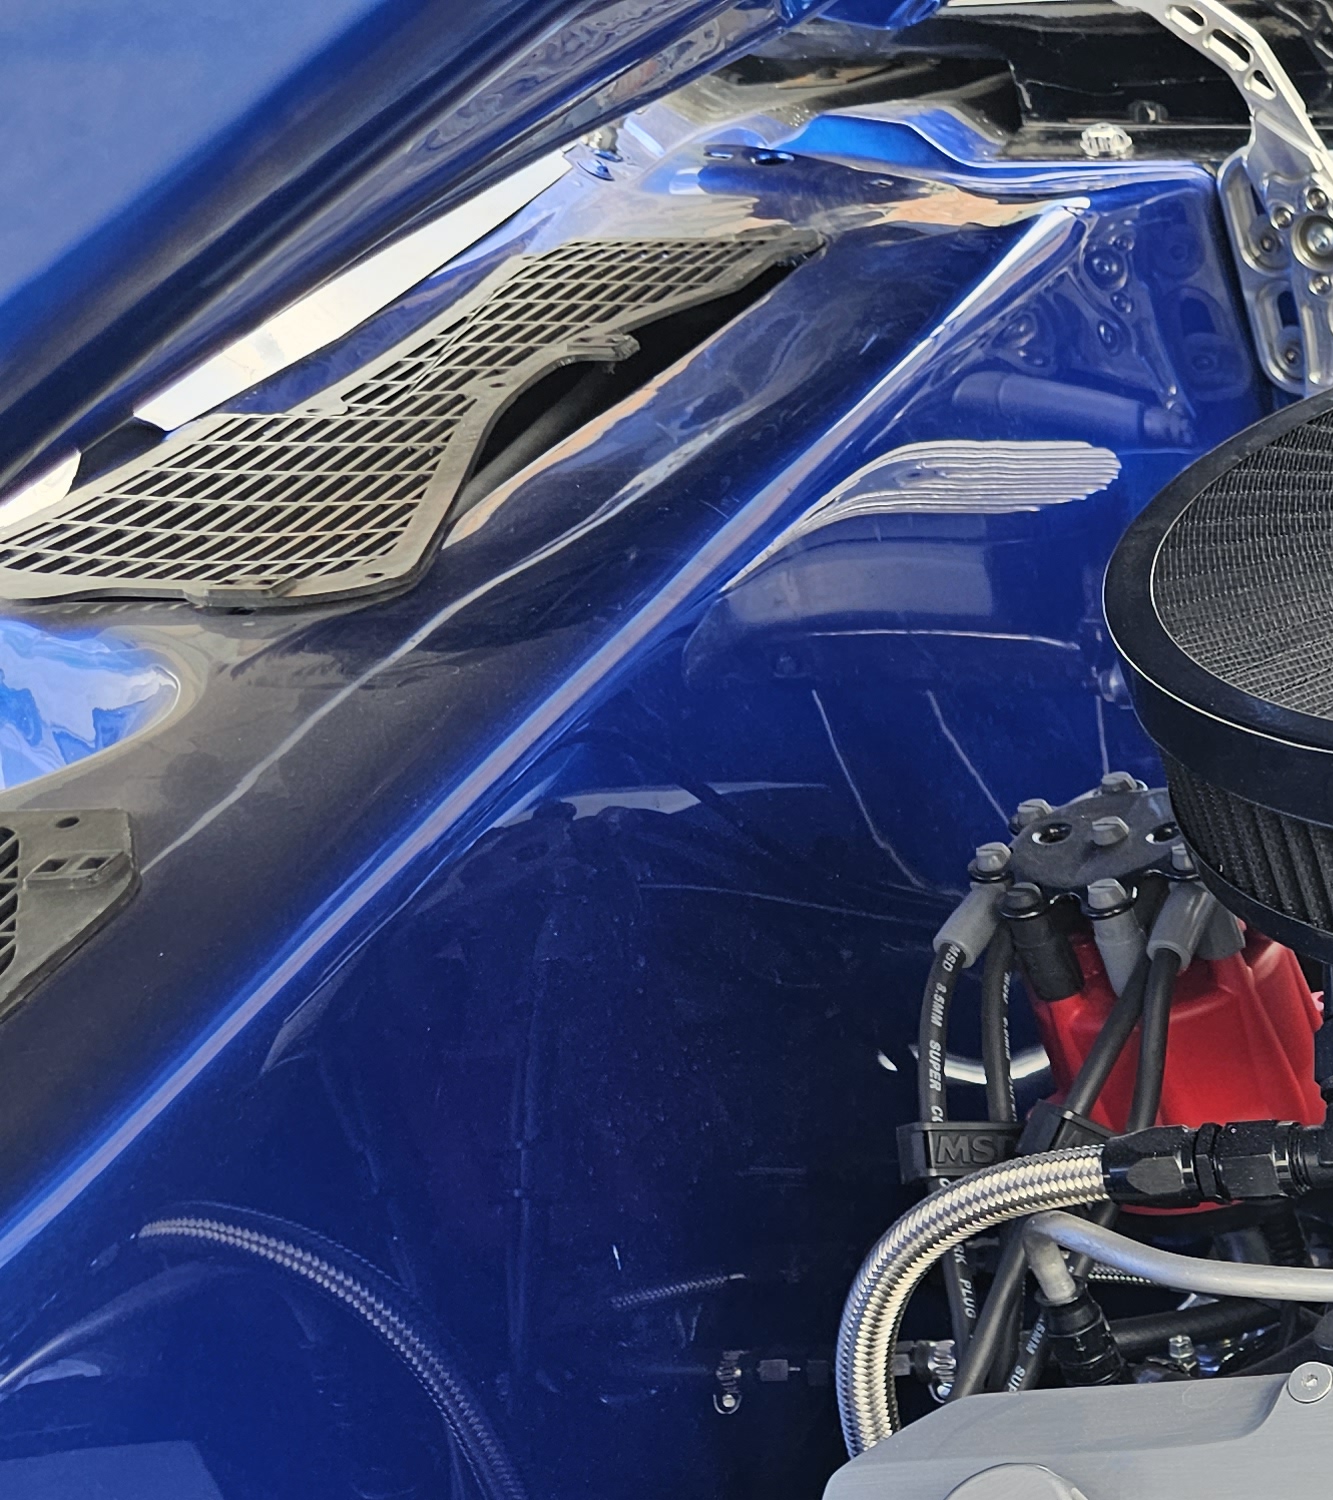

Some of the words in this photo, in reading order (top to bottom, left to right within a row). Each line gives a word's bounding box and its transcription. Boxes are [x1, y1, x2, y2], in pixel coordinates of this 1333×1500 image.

[943, 944, 961, 973] MSD
[930, 982, 948, 1028] 8.5MM
[929, 1039, 942, 1092] SUPER
[959, 1278, 977, 1319] PLUG
[1008, 1365, 1026, 1393] SUP
